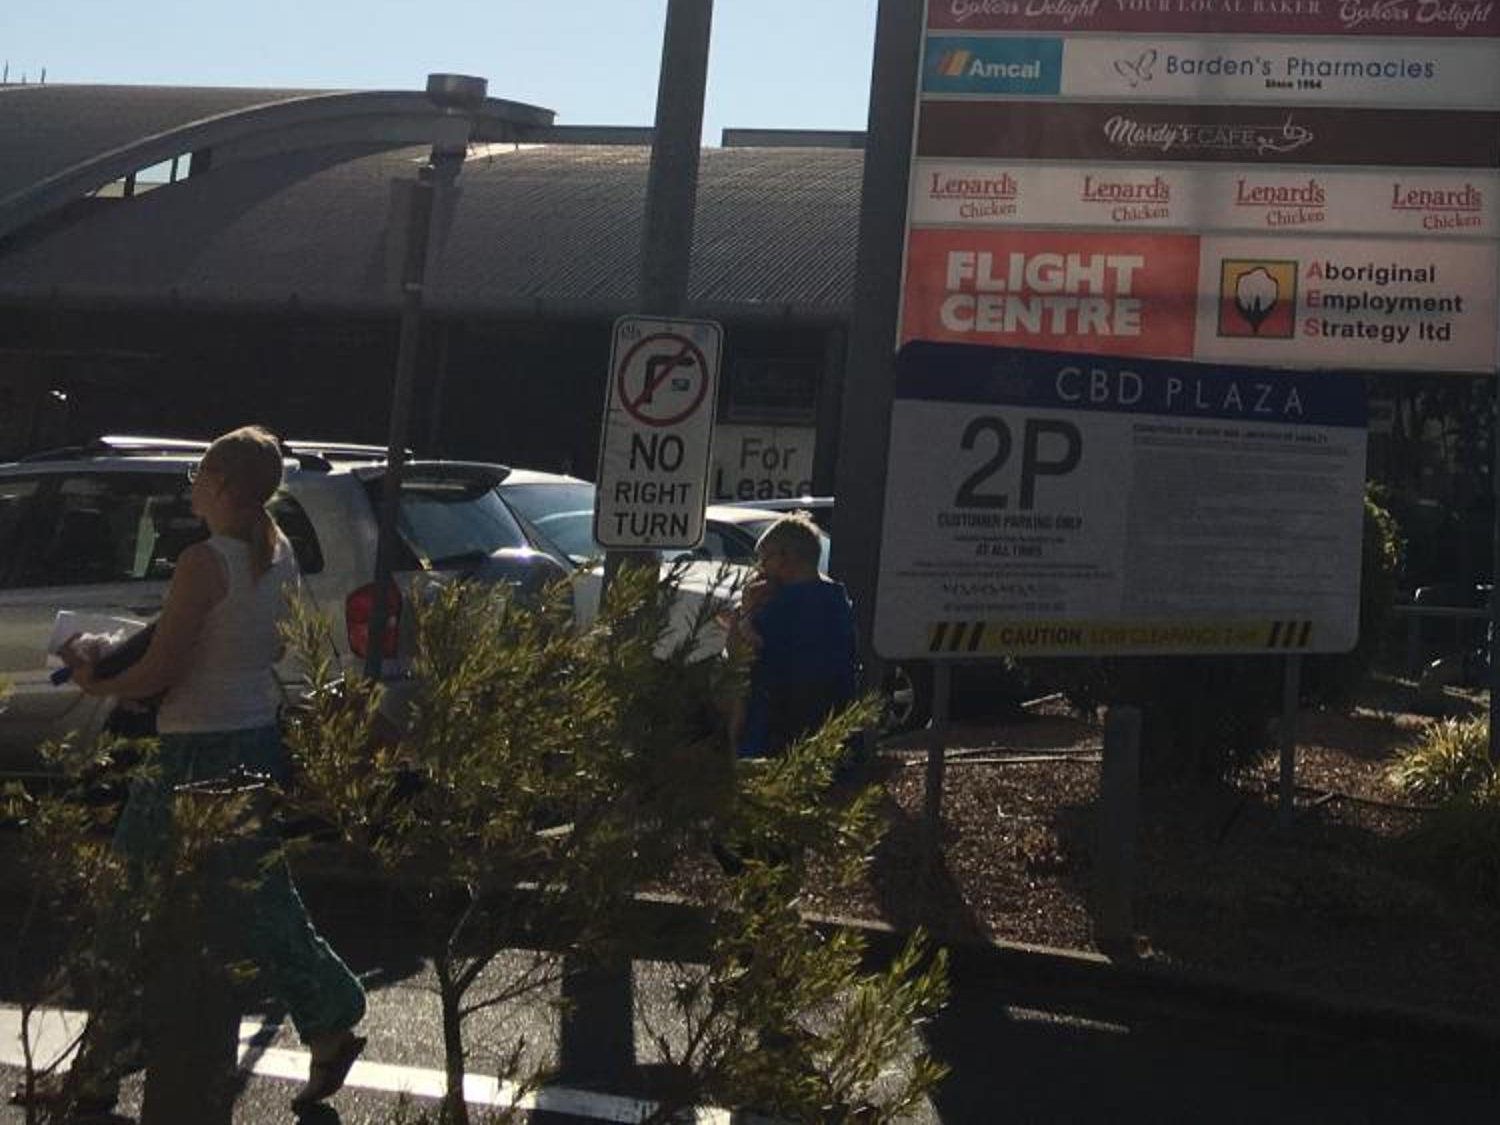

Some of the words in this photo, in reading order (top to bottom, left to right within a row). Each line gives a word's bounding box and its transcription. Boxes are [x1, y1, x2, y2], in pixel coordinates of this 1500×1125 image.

[968, 57, 1042, 81] Amcal
[1165, 54, 1272, 78] Barden's
[1287, 56, 1436, 81] Pharmacies
[930, 171, 1018, 197] Lenard's
[1081, 174, 1170, 200] Lenard's
[1234, 177, 1326, 204] Lenard's
[1391, 181, 1483, 209] Lenard's
[958, 200, 1017, 220] Chicken
[1110, 203, 1170, 223] Chicken
[1265, 207, 1325, 227] Chicken
[1422, 211, 1482, 230] Chicken
[945, 250, 1145, 294] FLIGHT
[1305, 261, 1436, 286] Aboriginal
[1304, 289, 1463, 316] Employment
[940, 296, 1142, 337] CENTRE
[1303, 317, 1410, 343] Strategy
[1417, 320, 1452, 342] ltd
[1054, 366, 1144, 405] CBD
[1166, 378, 1305, 416] PLAZA
[629, 433, 685, 473] NO
[739, 437, 797, 470] For
[953, 415, 1084, 512] 2P
[614, 481, 692, 506] RIGHT
[714, 468, 815, 500] Lease
[613, 512, 690, 538] TURN
[1000, 627, 1082, 646] CAUTION
